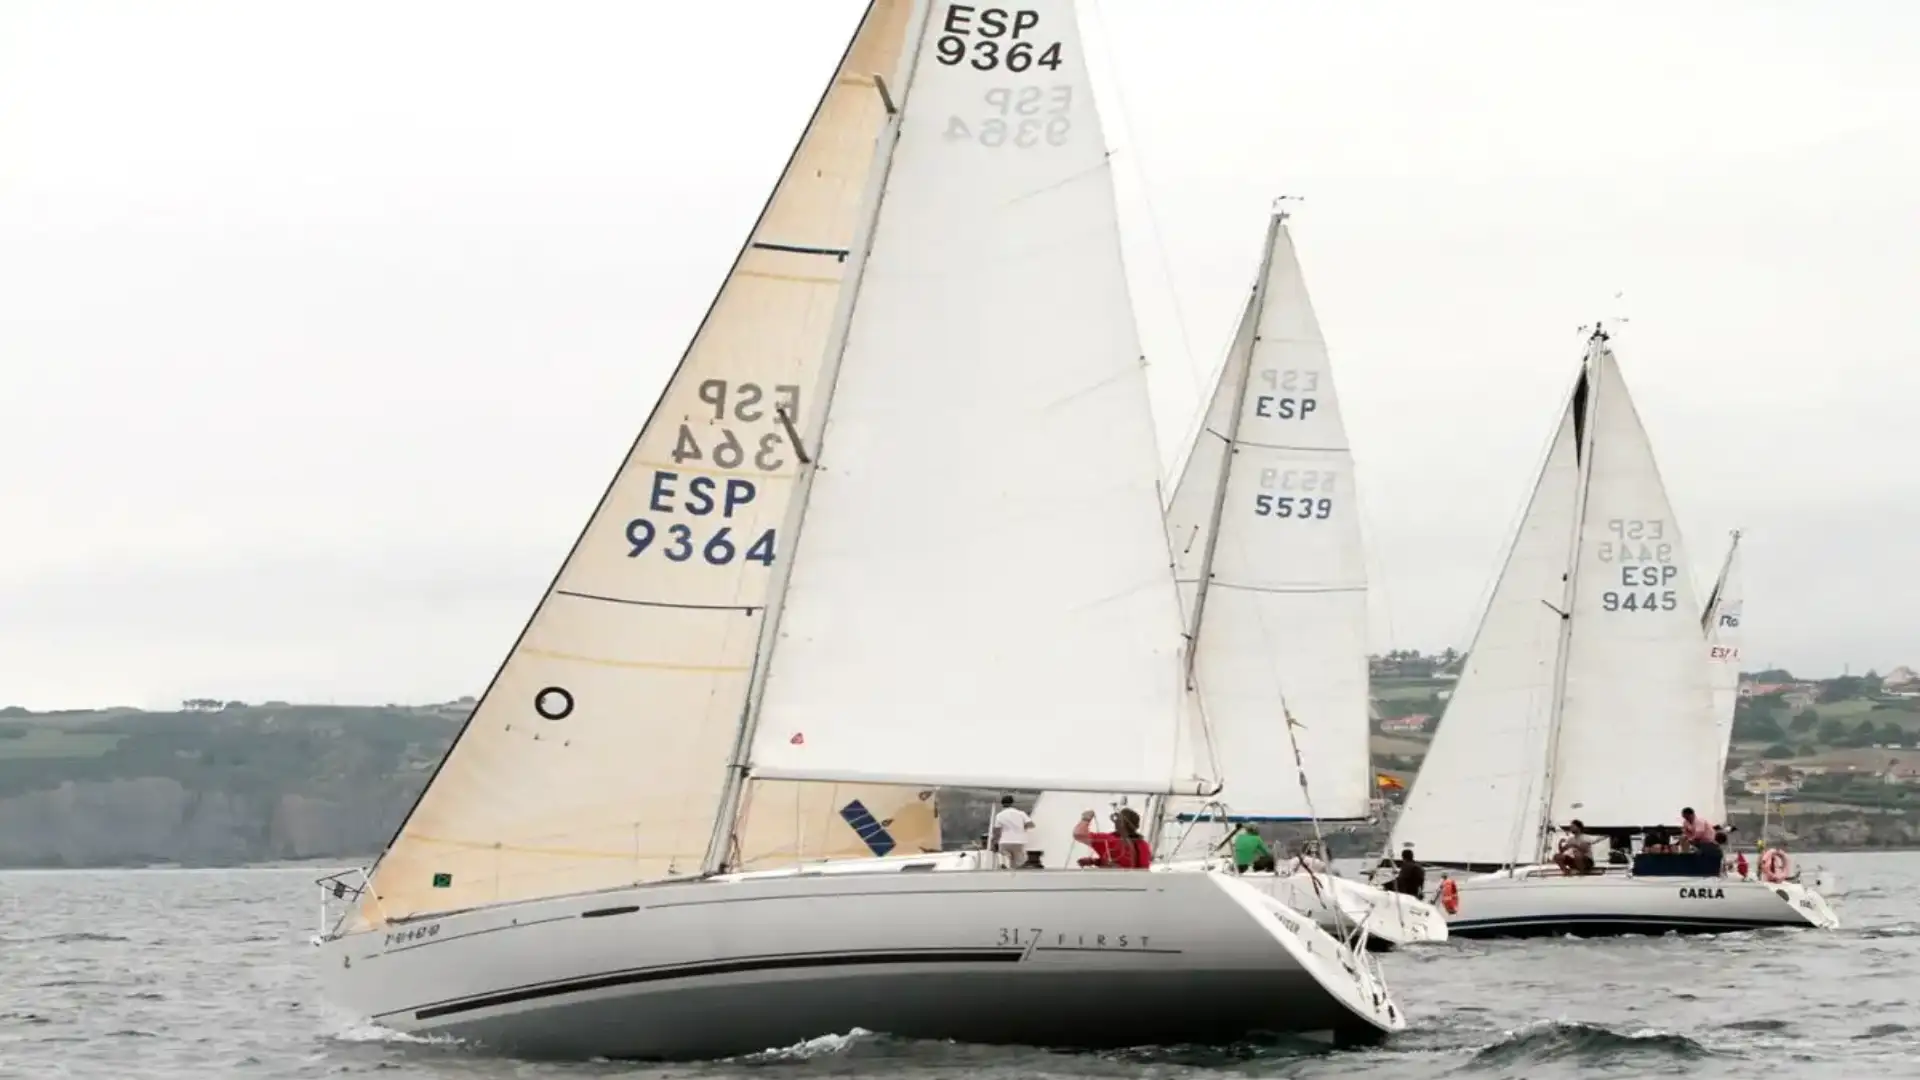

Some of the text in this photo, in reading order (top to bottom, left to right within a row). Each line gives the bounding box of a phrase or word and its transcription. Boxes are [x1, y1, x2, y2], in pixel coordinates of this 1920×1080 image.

[944, 4, 1039, 39] ESP
[936, 35, 1062, 72] 9364
[1256, 396, 1317, 420] ESP
[650, 471, 756, 518] ESP
[1255, 494, 1332, 519] 5539
[626, 518, 776, 567] 9364
[1622, 566, 1678, 587] ESP
[1602, 591, 1677, 612] 9445
[1679, 888, 1725, 899] CARLA
[1058, 933, 1149, 948] FIRST
